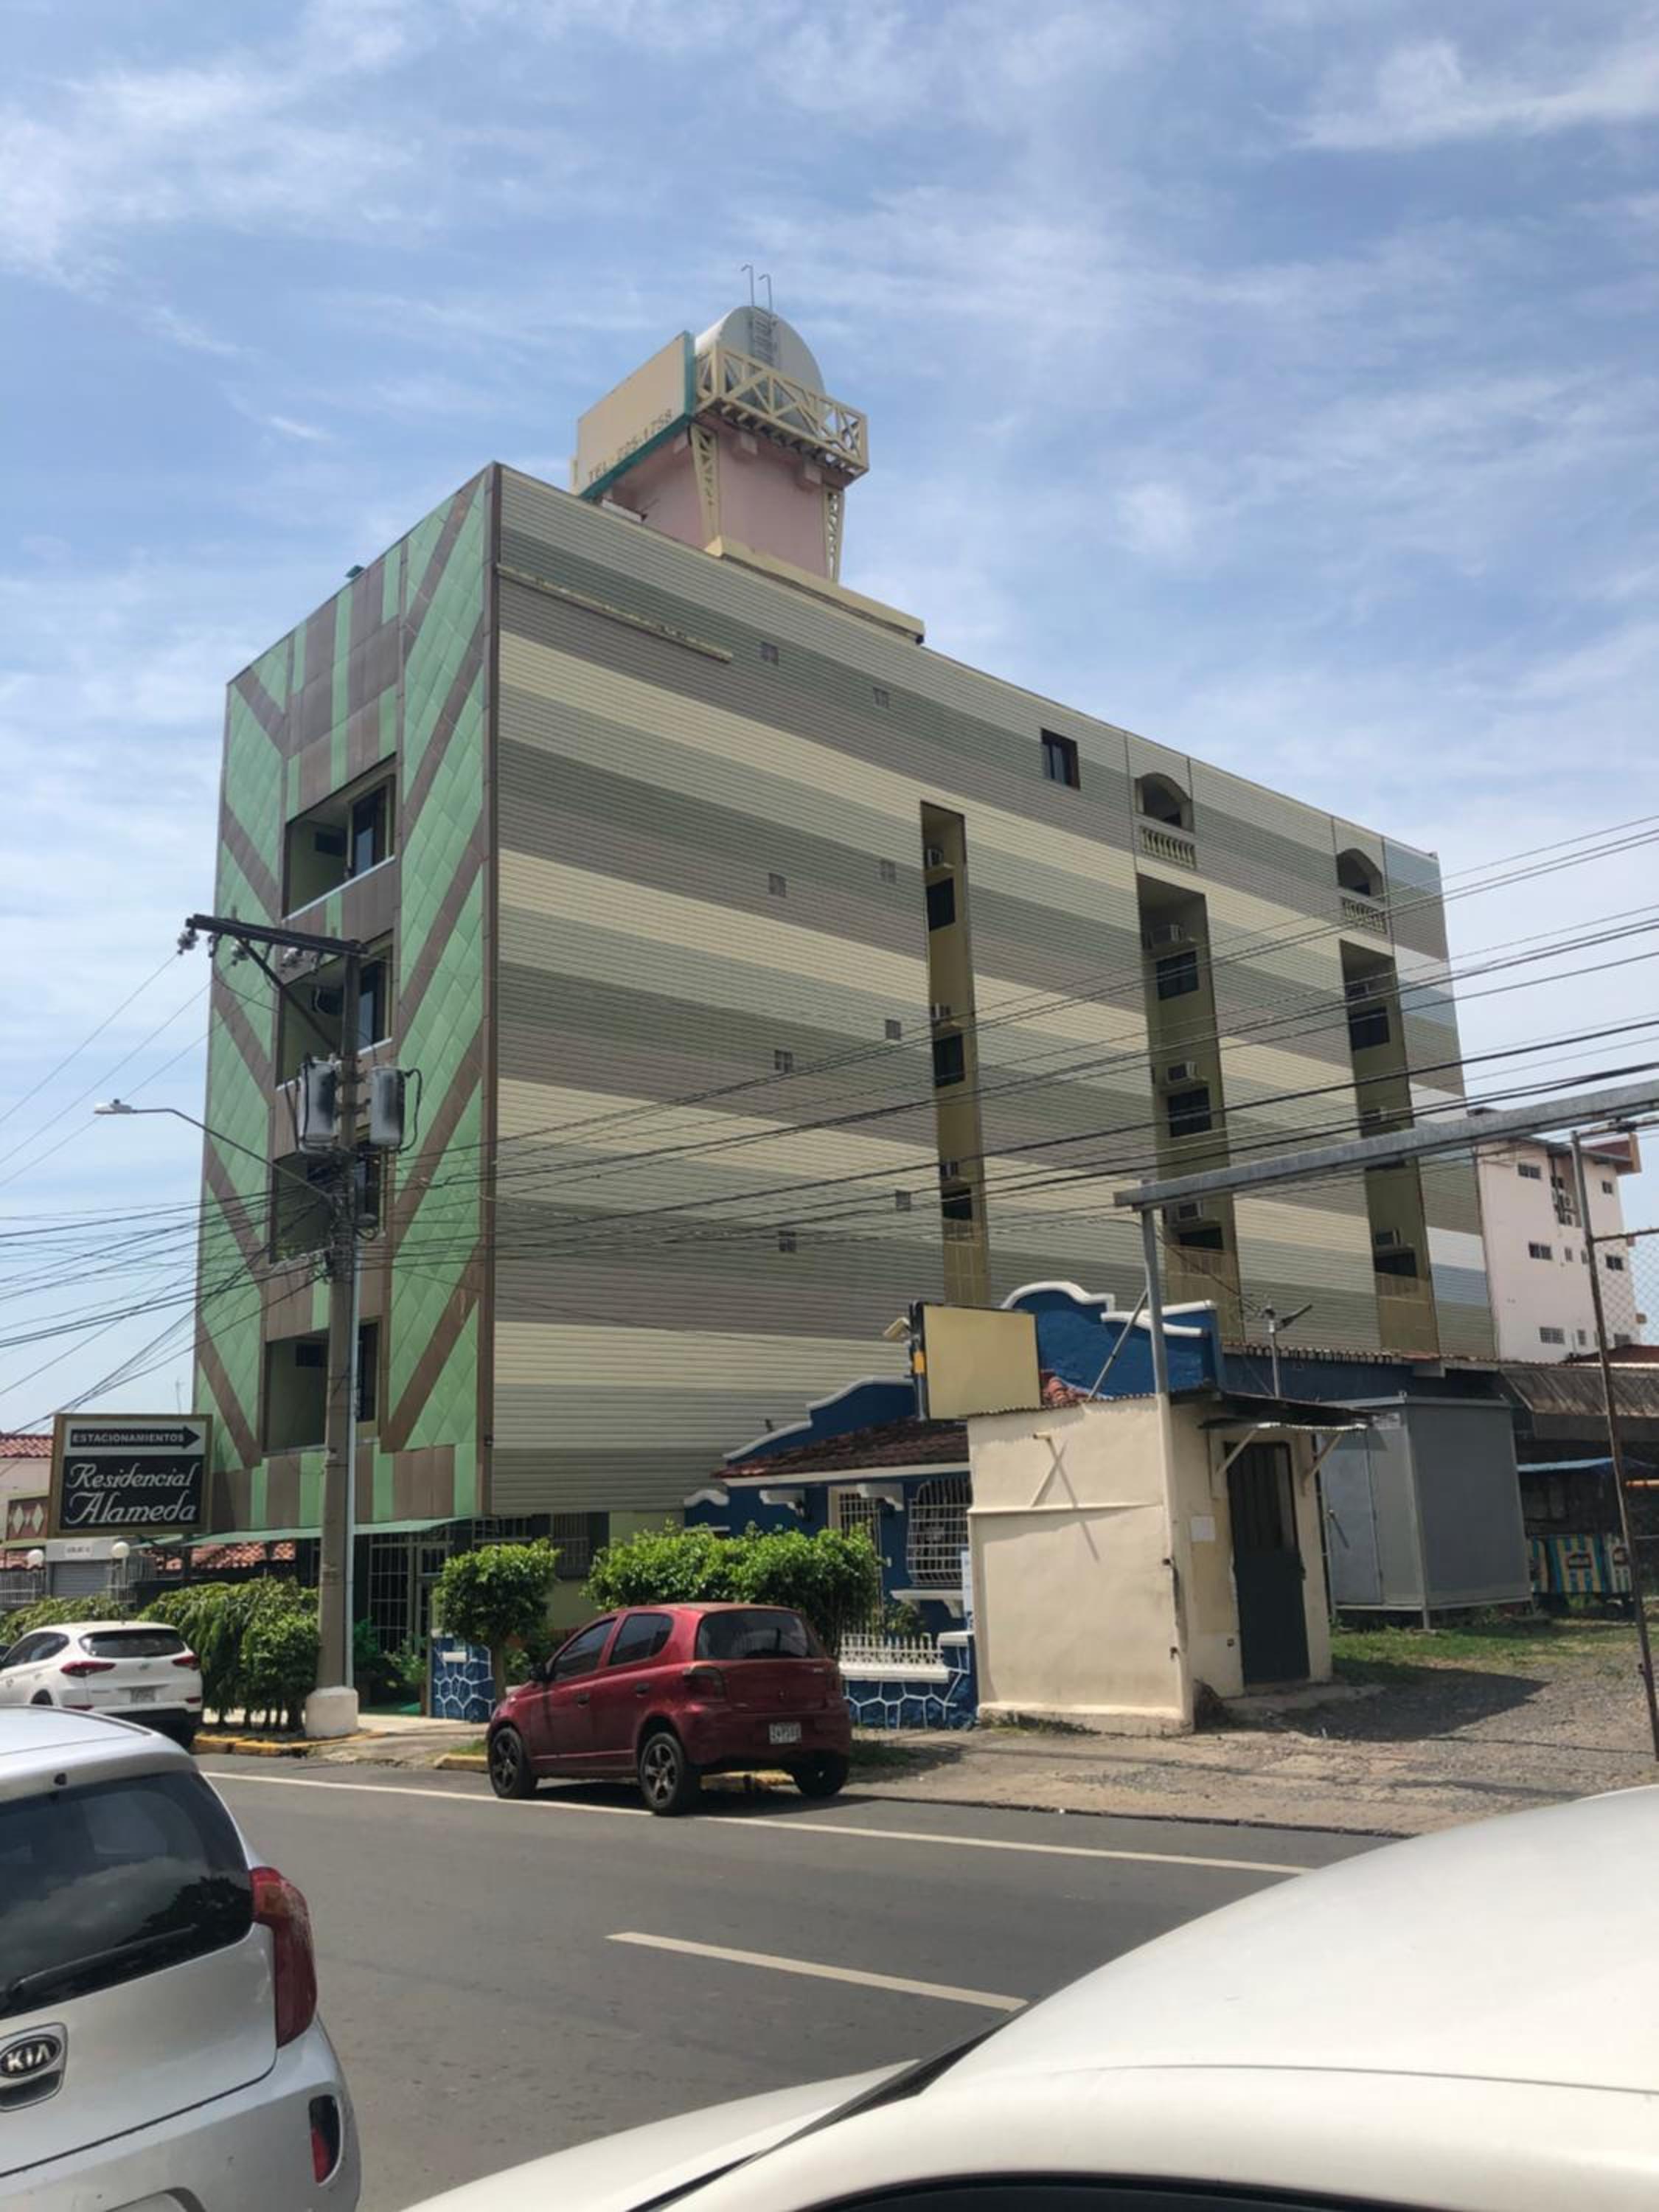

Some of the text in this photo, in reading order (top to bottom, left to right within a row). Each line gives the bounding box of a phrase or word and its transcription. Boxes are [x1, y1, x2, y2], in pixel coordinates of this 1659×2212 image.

[72, 1432, 185, 1442] ESTACIONAMIENTOS
[67, 1463, 201, 1488] Residencial
[65, 1490, 196, 1524] Alameda
[7, 2043, 52, 2073] KIA
